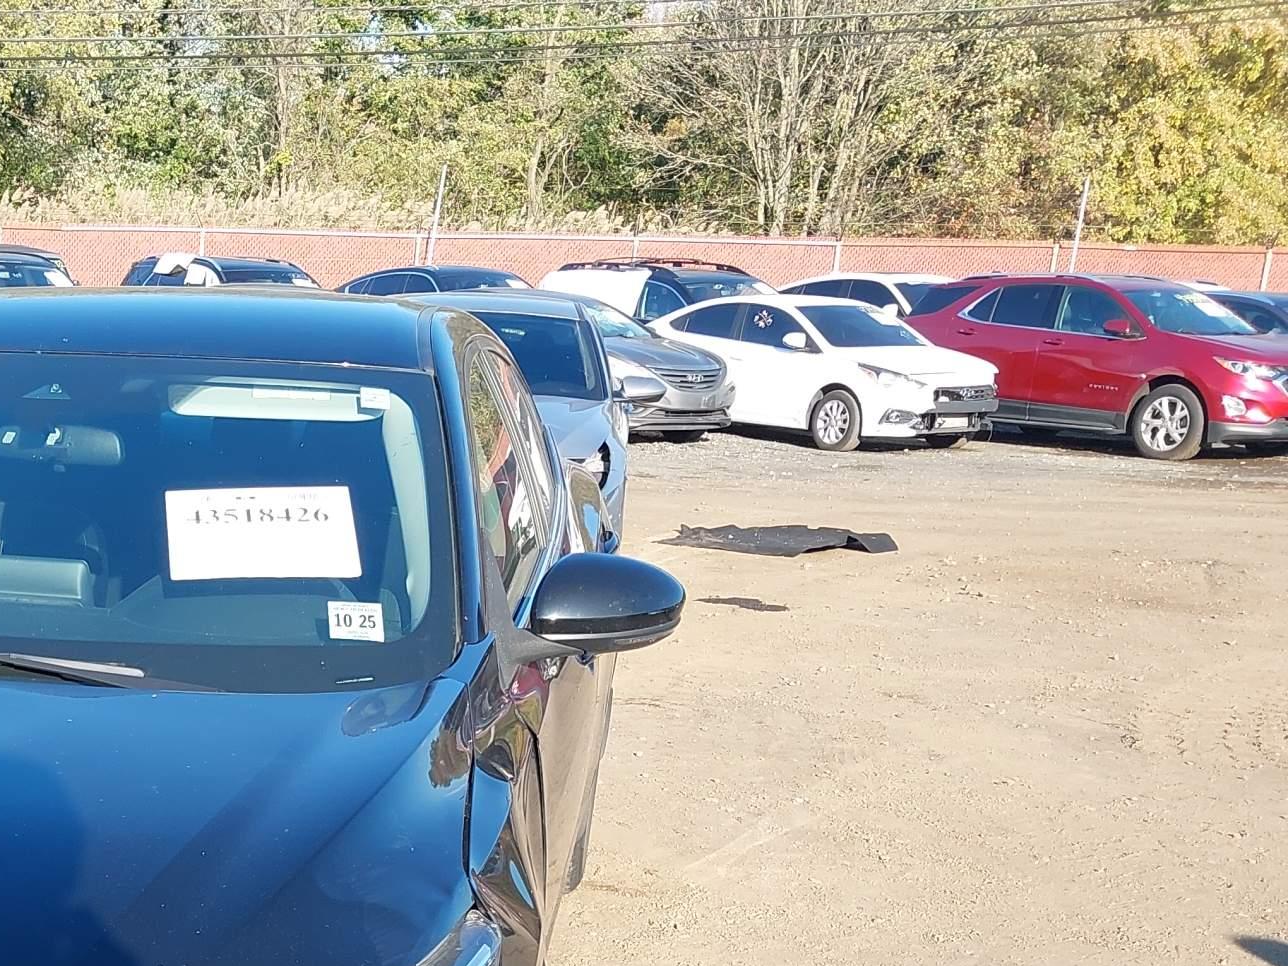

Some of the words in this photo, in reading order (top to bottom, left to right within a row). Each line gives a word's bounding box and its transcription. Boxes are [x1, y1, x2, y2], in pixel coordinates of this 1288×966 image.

[186, 507, 329, 524] 43518426
[335, 613, 353, 628] 10
[359, 614, 376, 629] 25
